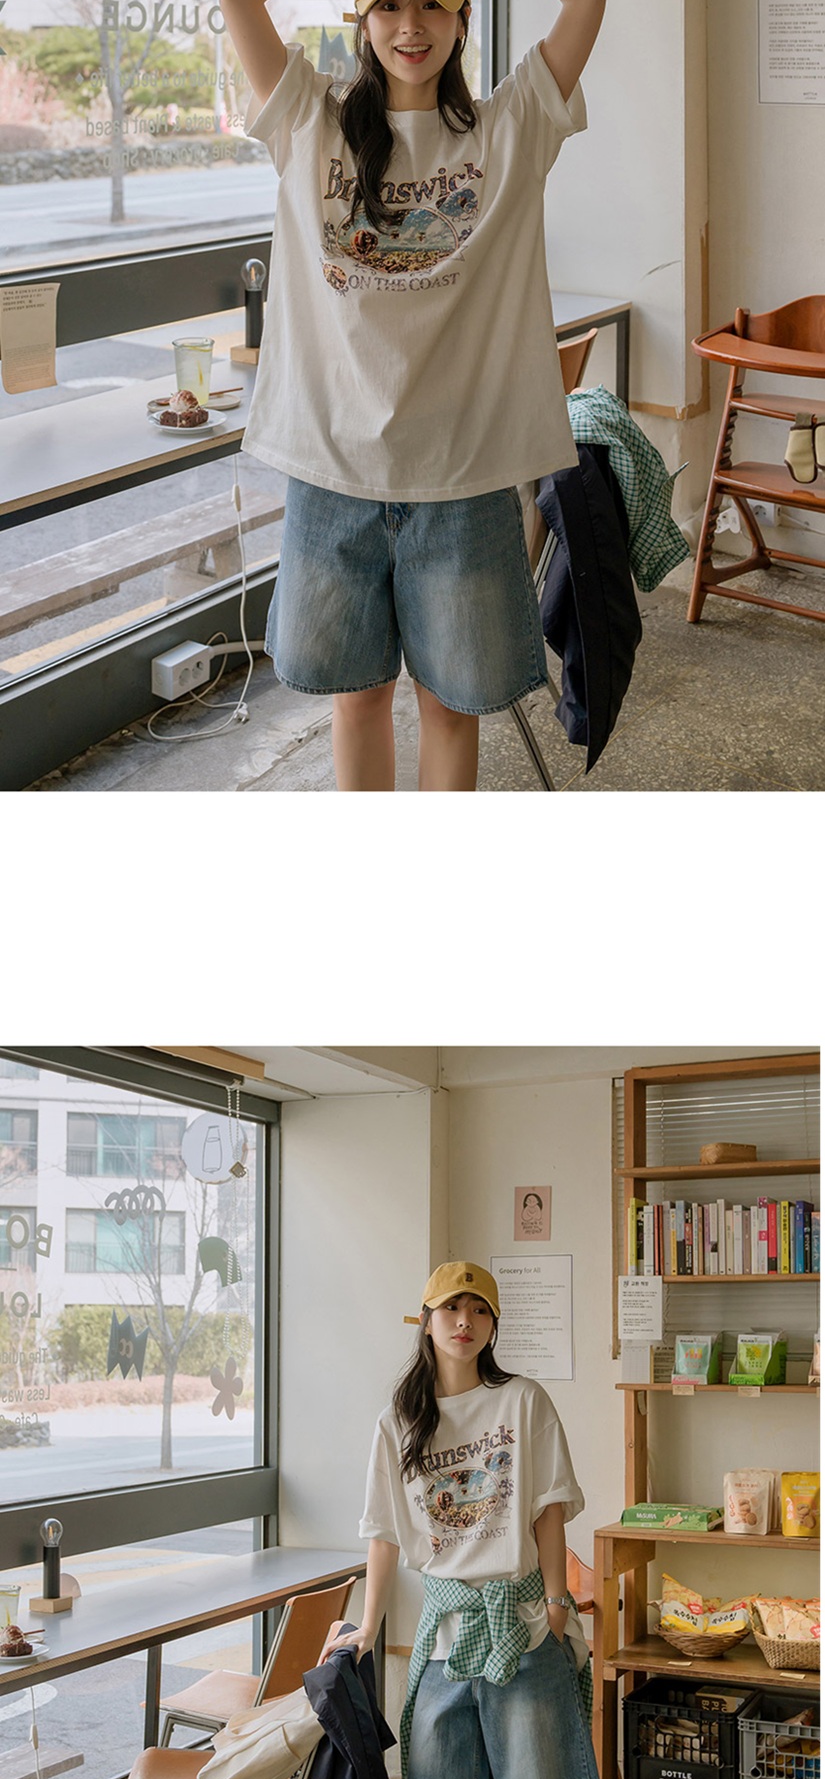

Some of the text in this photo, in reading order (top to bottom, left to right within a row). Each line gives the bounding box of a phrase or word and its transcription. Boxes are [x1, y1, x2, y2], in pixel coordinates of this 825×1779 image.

[323, 158, 484, 205] Brnswick
[348, 272, 461, 293] ON THE COAST
[465, 1272, 474, 1282] B
[499, 1267, 523, 1275] Grocery
[474, 1526, 508, 1541] COAST
[661, 1769, 693, 1779] BOTTLE
